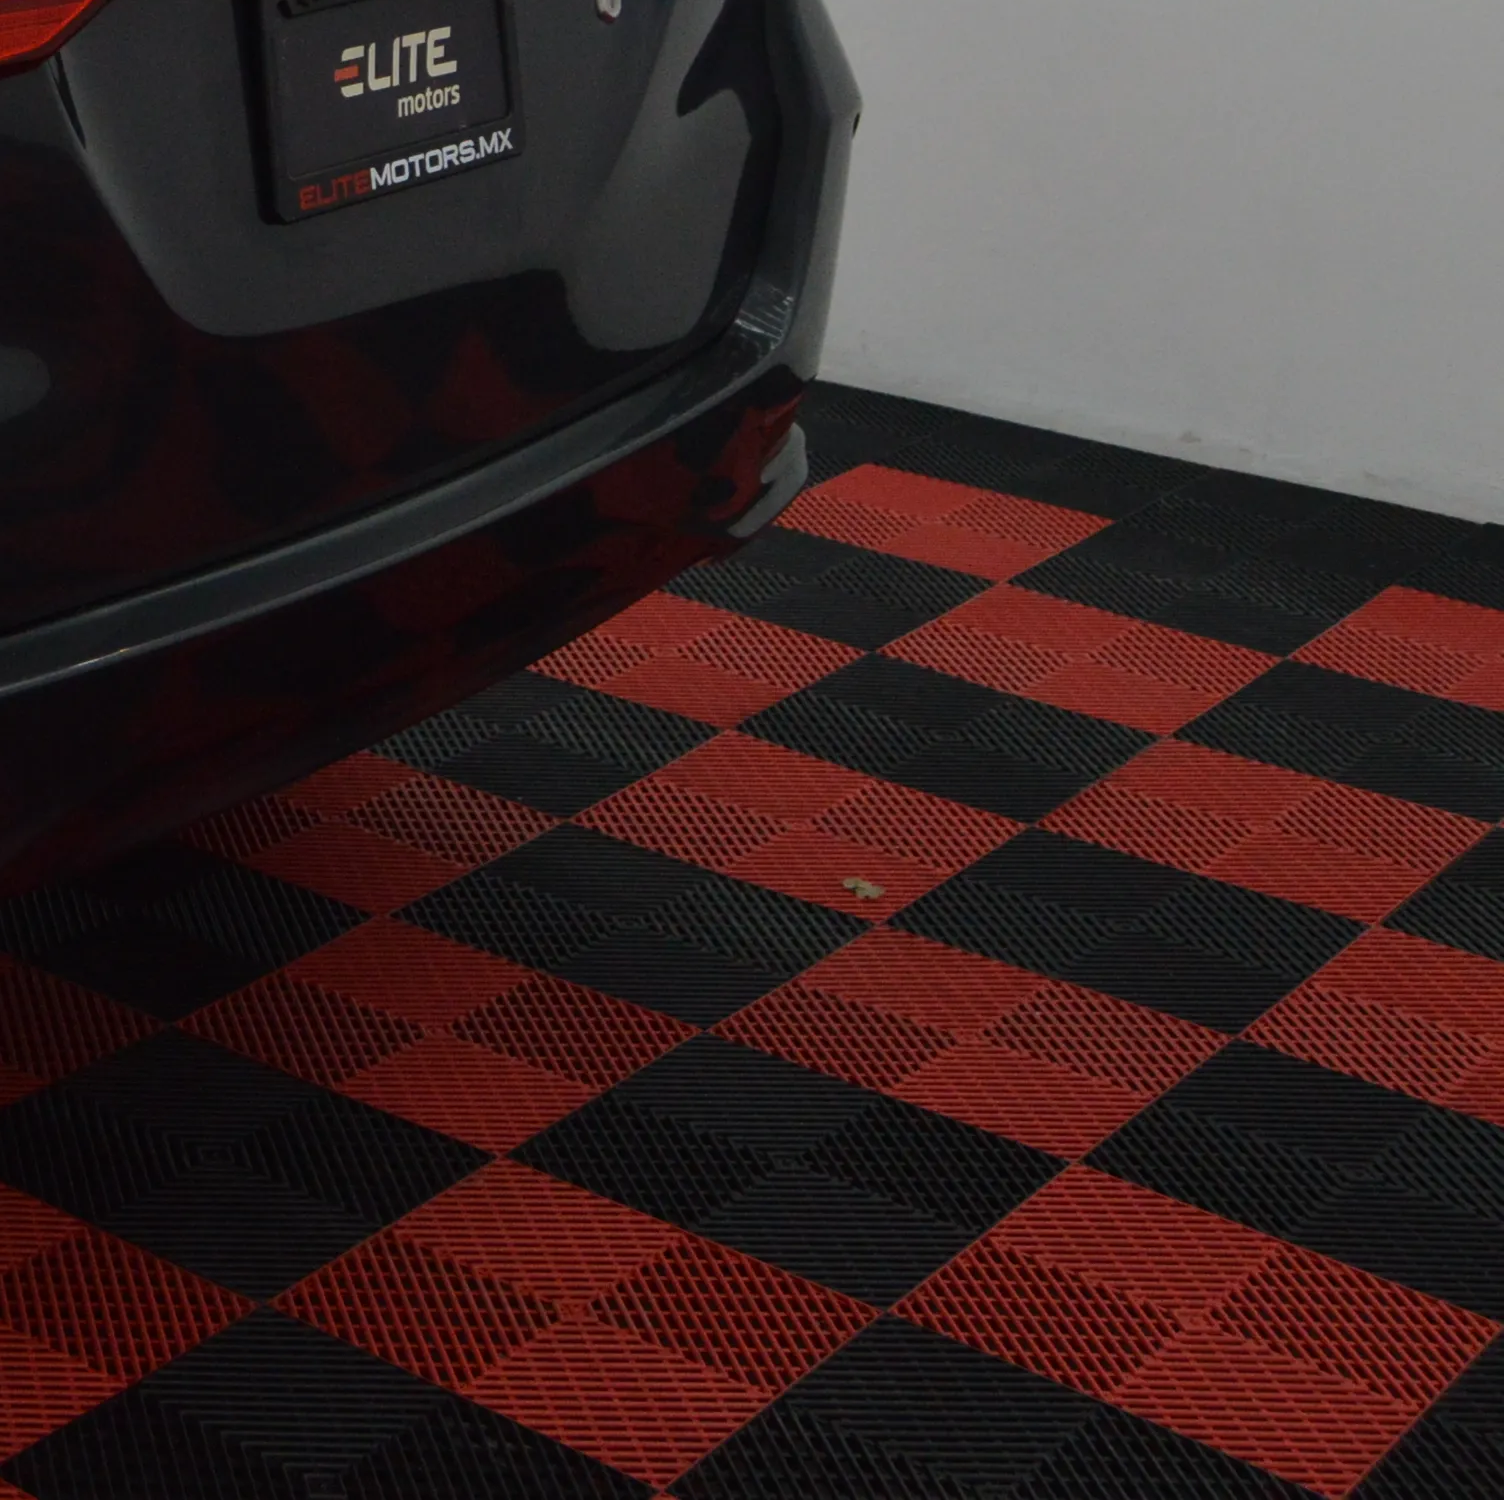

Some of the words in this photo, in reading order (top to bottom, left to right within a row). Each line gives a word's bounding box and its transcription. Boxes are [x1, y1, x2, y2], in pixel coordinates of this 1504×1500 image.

[334, 26, 458, 98] ELITE
[397, 84, 460, 118] motors
[299, 128, 513, 211] ELITEMOTORS.MX
